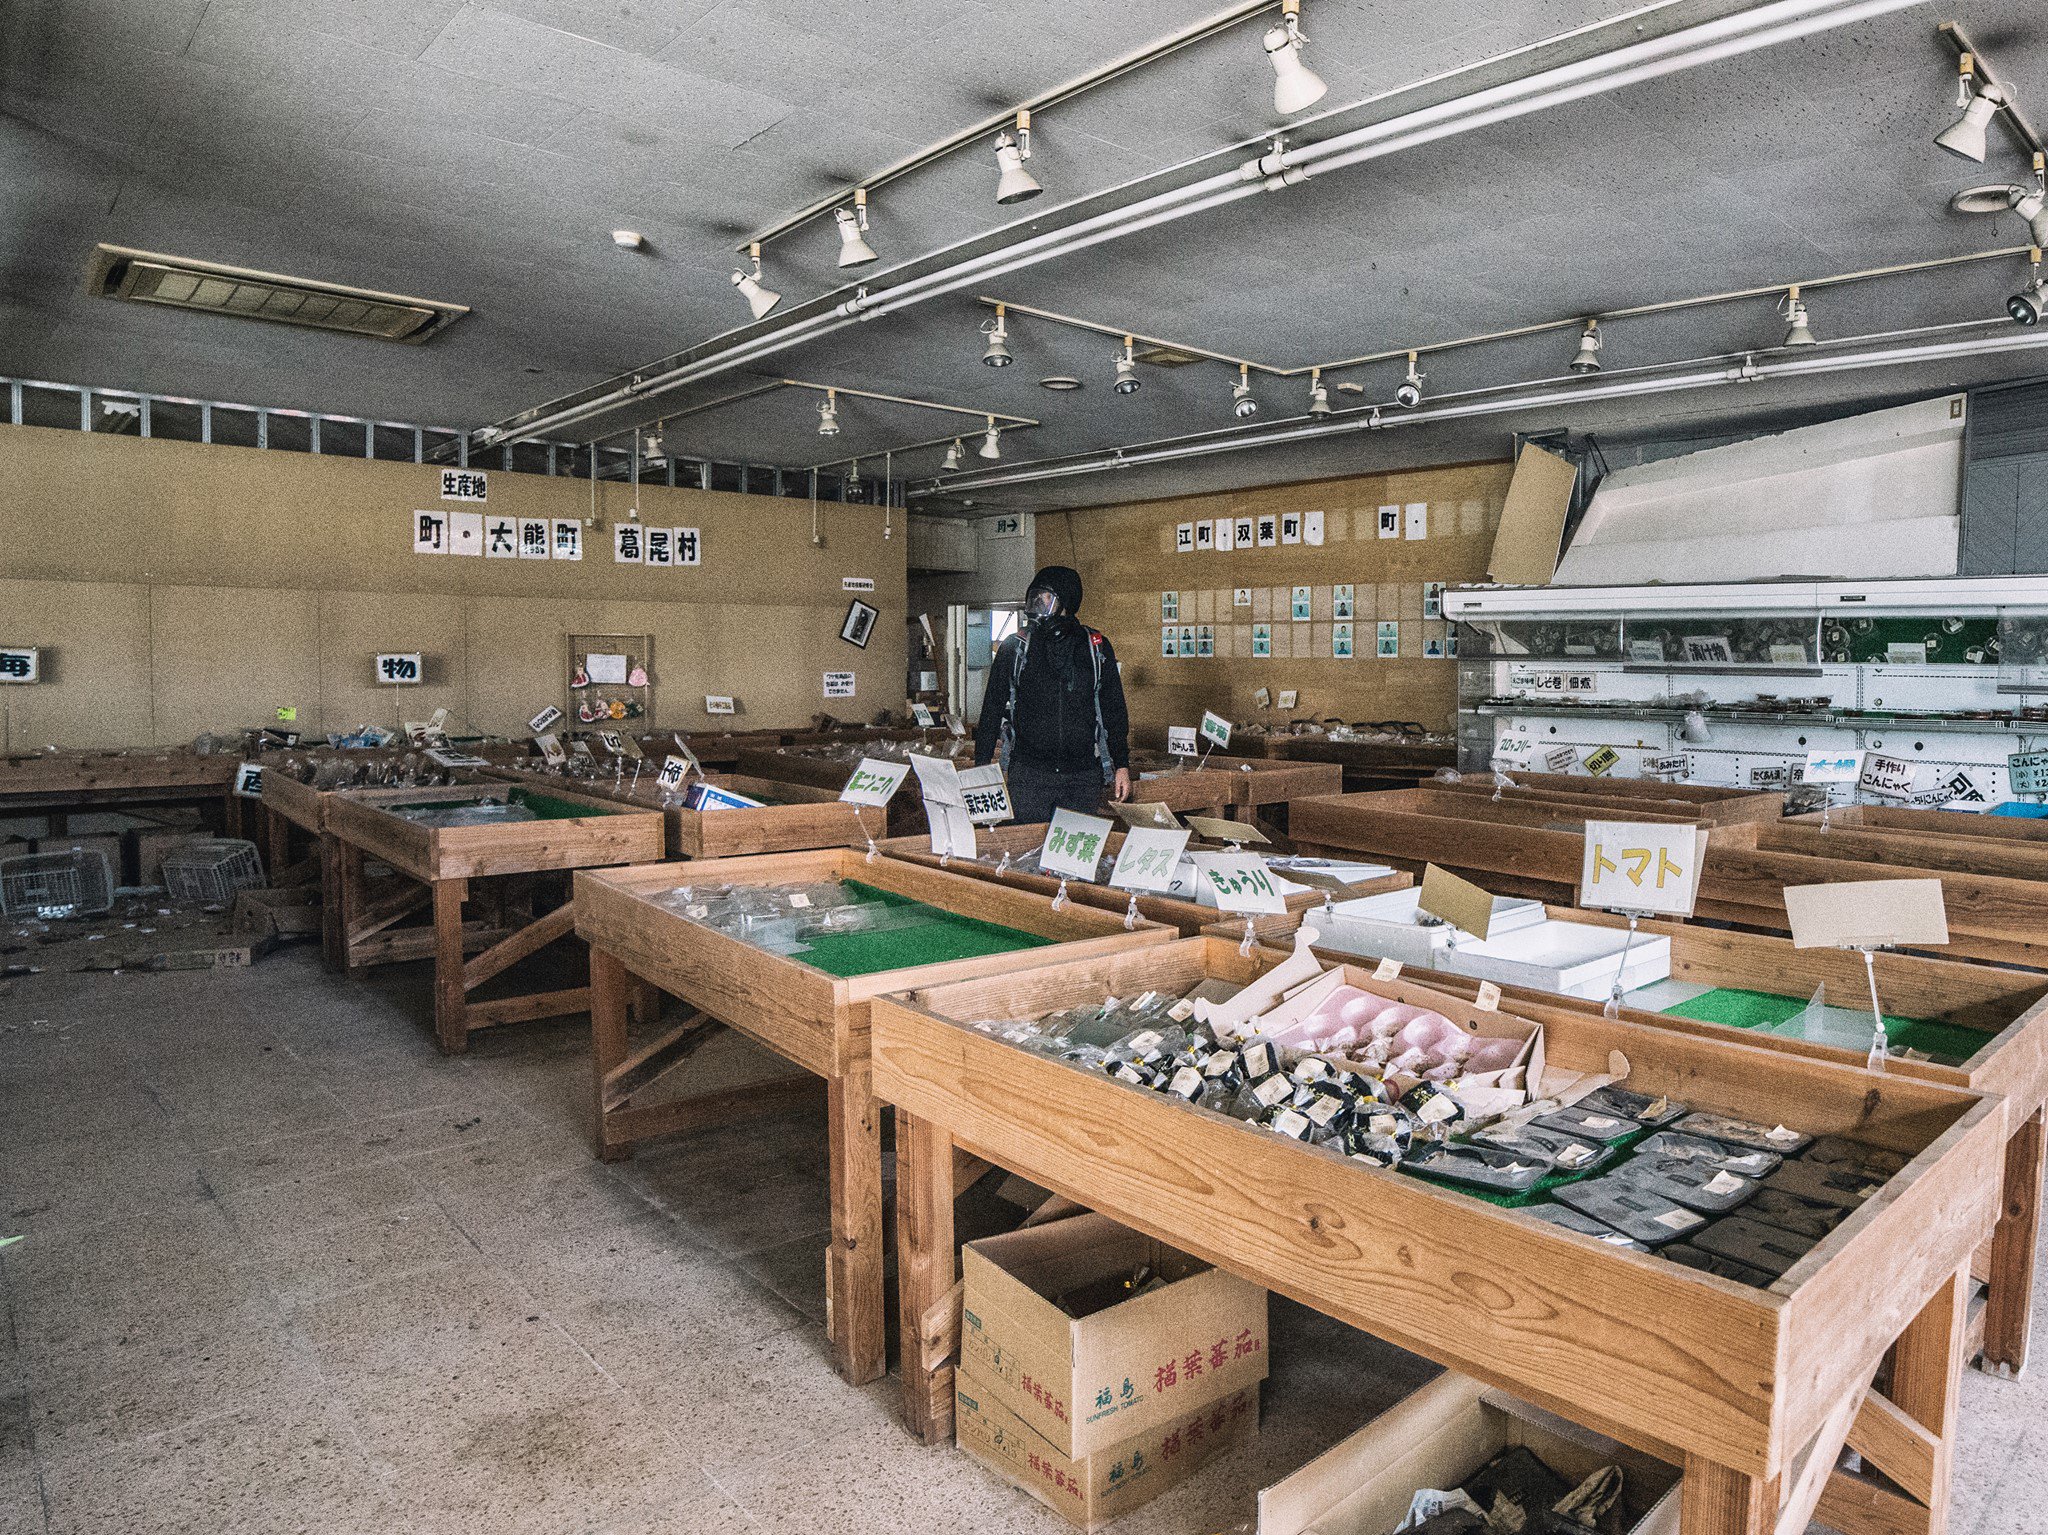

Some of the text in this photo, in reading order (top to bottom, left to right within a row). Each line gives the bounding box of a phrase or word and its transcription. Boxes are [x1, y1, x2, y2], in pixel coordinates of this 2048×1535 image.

[442, 473, 487, 499] 生産地
[1689, 643, 1727, 662] 漬け物
[382, 658, 417, 680] 物
[1537, 676, 1562, 690] しそ巻
[1569, 676, 1592, 690] 佃煮
[1875, 758, 1906, 776] 手作り
[1862, 773, 1911, 794] こんにゃく
[964, 789, 1008, 816] 葉たまねぎ
[1048, 826, 1101, 864] みず菜
[1118, 844, 1175, 878] レタス
[1592, 844, 1683, 890] トマト
[1208, 868, 1275, 897] きゅうり
[1095, 1377, 1135, 1409] 福島
